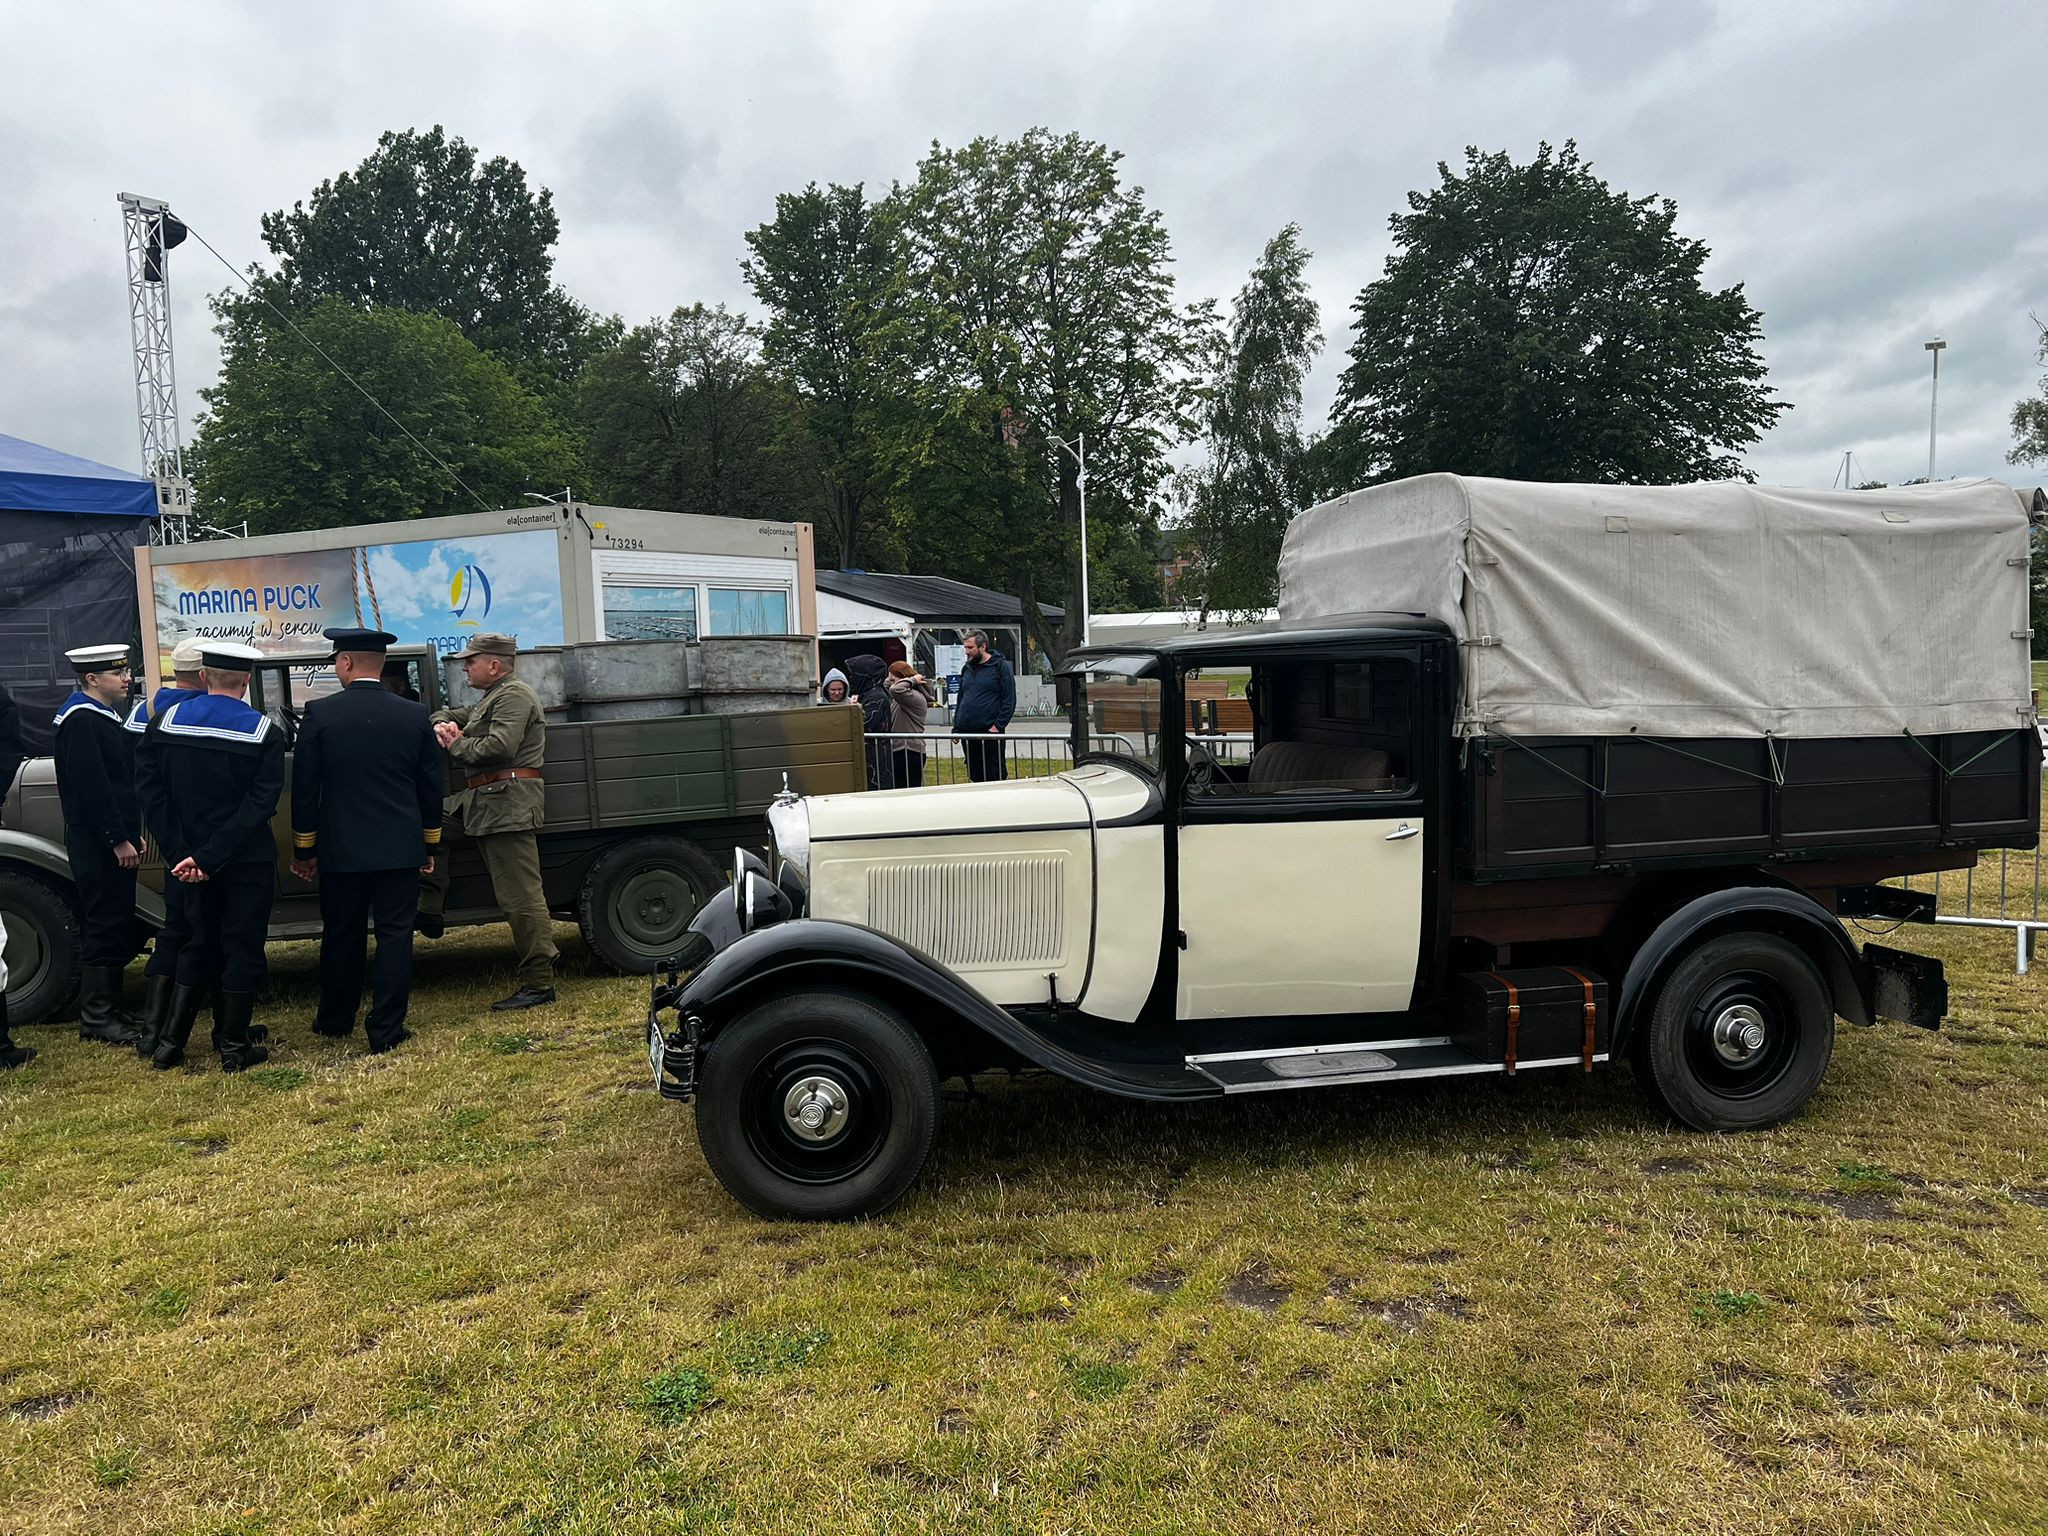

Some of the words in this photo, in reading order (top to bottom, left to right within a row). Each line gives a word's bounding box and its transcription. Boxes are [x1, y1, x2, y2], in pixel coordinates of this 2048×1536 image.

[507, 512, 556, 526] ela[container]
[759, 526, 797, 537] ela[container
[611, 538, 644, 550] 73294
[179, 587, 258, 615] MARINA
[263, 584, 322, 611] PUCK
[195, 620, 256, 647] zacumuj
[261, 618, 273, 638] w
[278, 620, 323, 641] sercu
